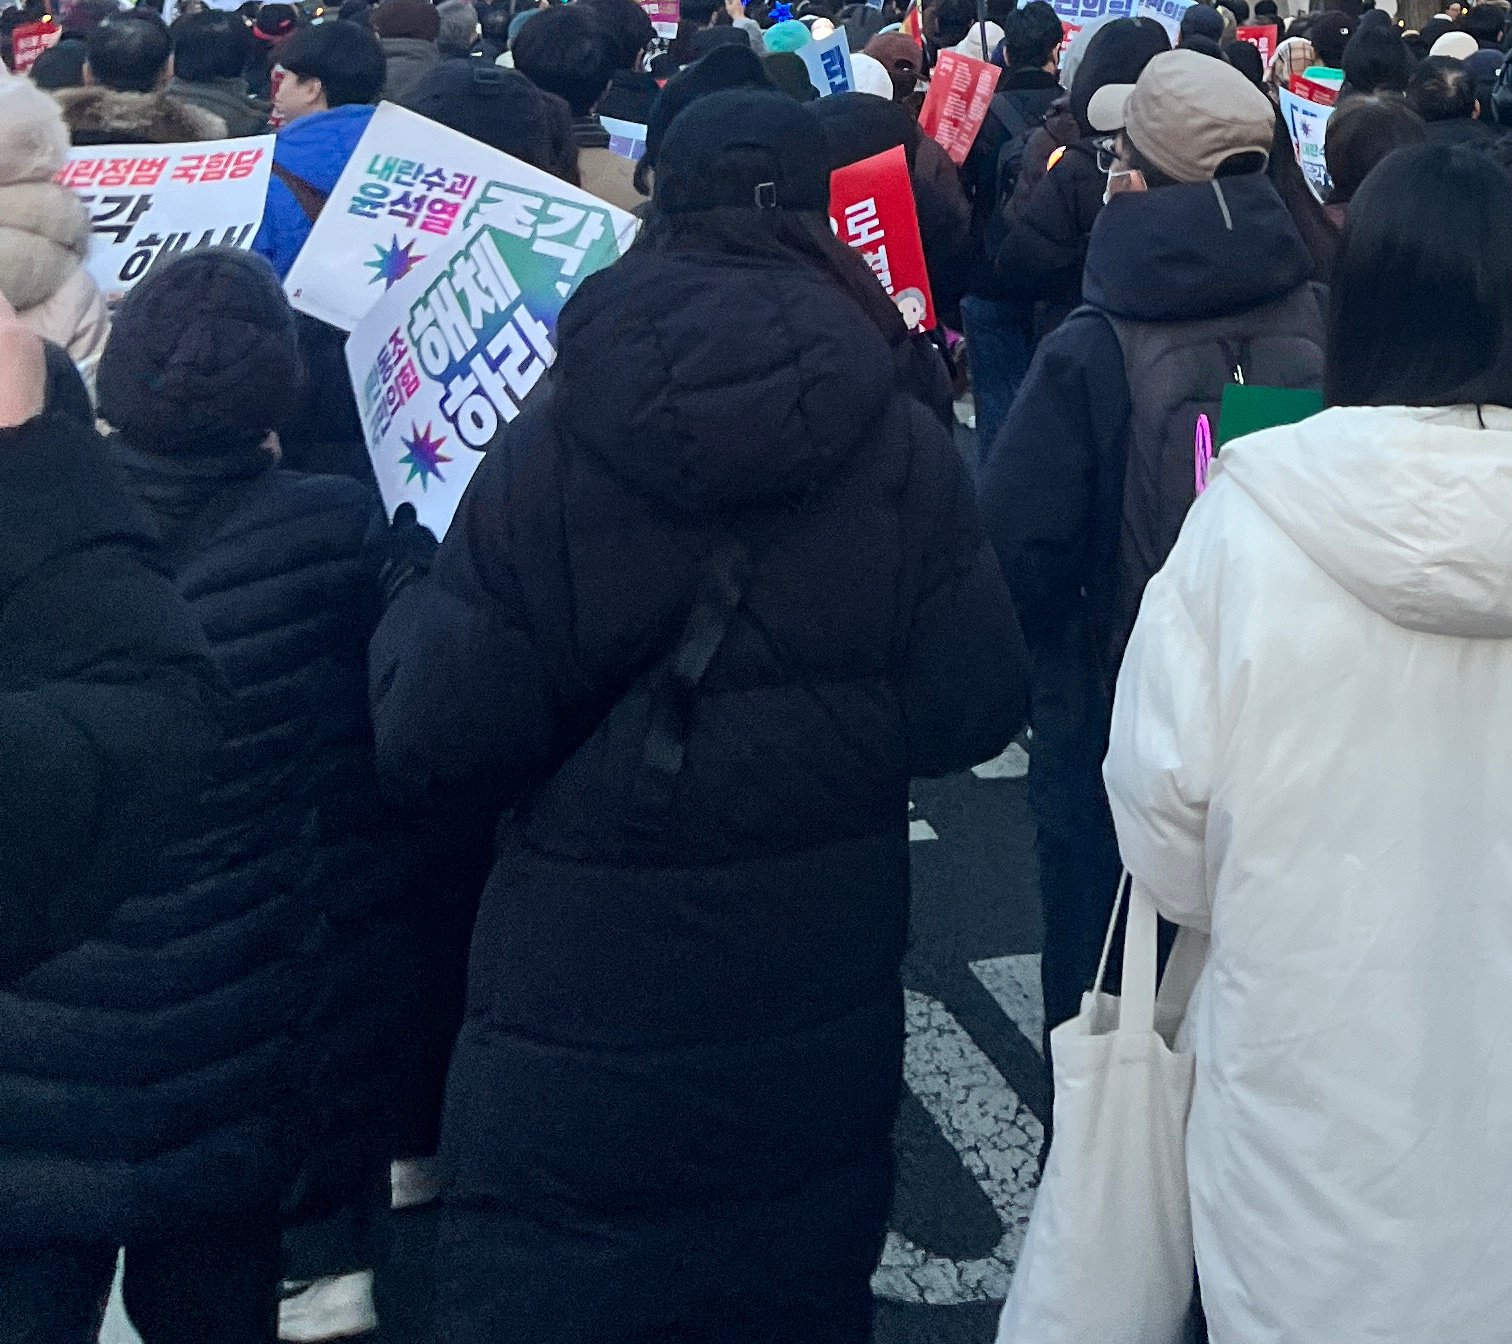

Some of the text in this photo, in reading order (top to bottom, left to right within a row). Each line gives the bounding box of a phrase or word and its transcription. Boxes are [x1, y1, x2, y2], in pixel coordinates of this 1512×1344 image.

[171, 146, 264, 185] 국힘당
[366, 154, 477, 199] 내란수괴
[81, 193, 154, 245] 각
[348, 182, 462, 235] 윤석열
[411, 230, 521, 375] 해체
[444, 304, 556, 447] 하라
